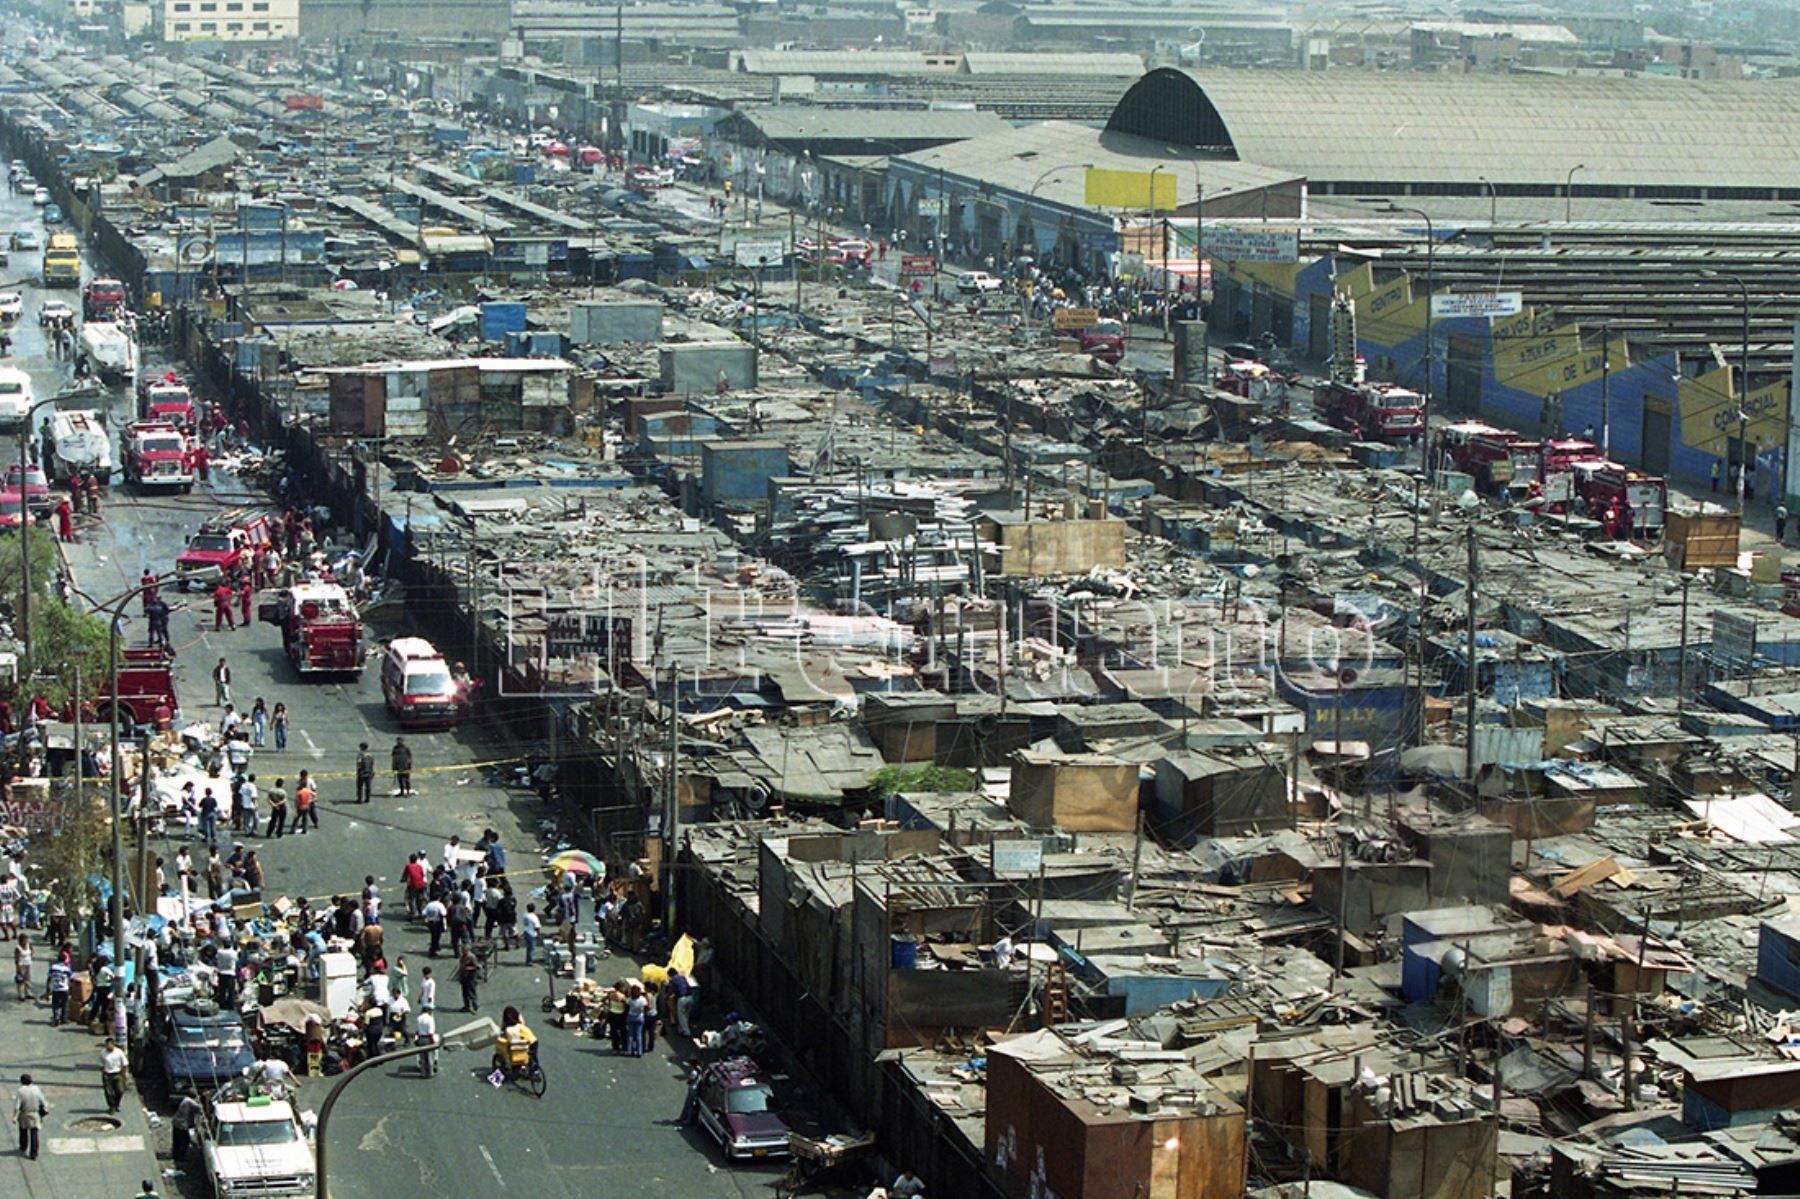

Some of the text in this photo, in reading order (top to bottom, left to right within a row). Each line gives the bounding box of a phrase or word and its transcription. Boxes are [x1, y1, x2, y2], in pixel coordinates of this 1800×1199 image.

[1370, 287, 1402, 313] CENTRO
[1563, 354, 1608, 381] DE LIM
[1714, 392, 1777, 428] COMRCIAL
